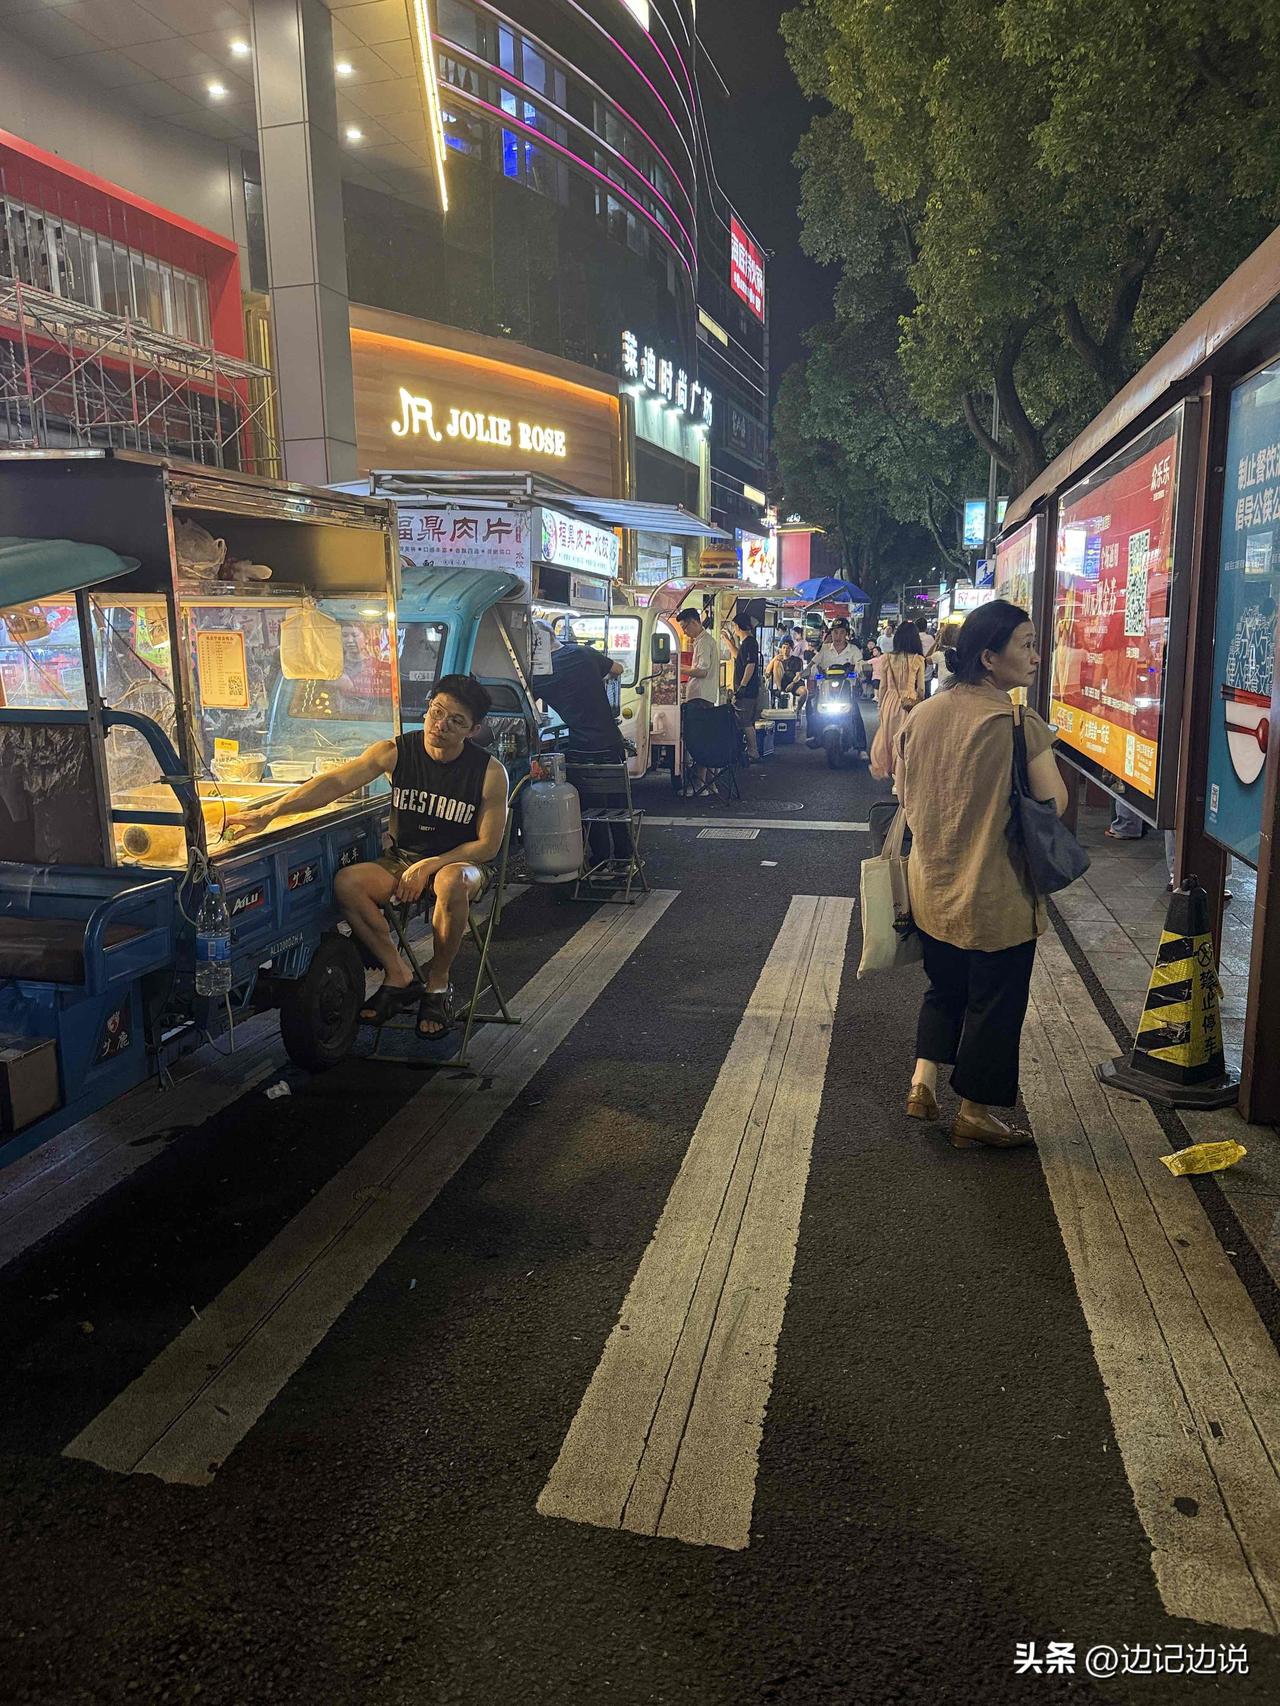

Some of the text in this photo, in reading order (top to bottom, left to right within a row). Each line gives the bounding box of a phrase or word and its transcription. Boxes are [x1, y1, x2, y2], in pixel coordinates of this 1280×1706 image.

[446, 408, 512, 446] JOLIE
[518, 422, 567, 457] ROSE
[398, 515, 513, 544] 福鼎肉片
[1200, 970, 1217, 1057] 禁止停车
